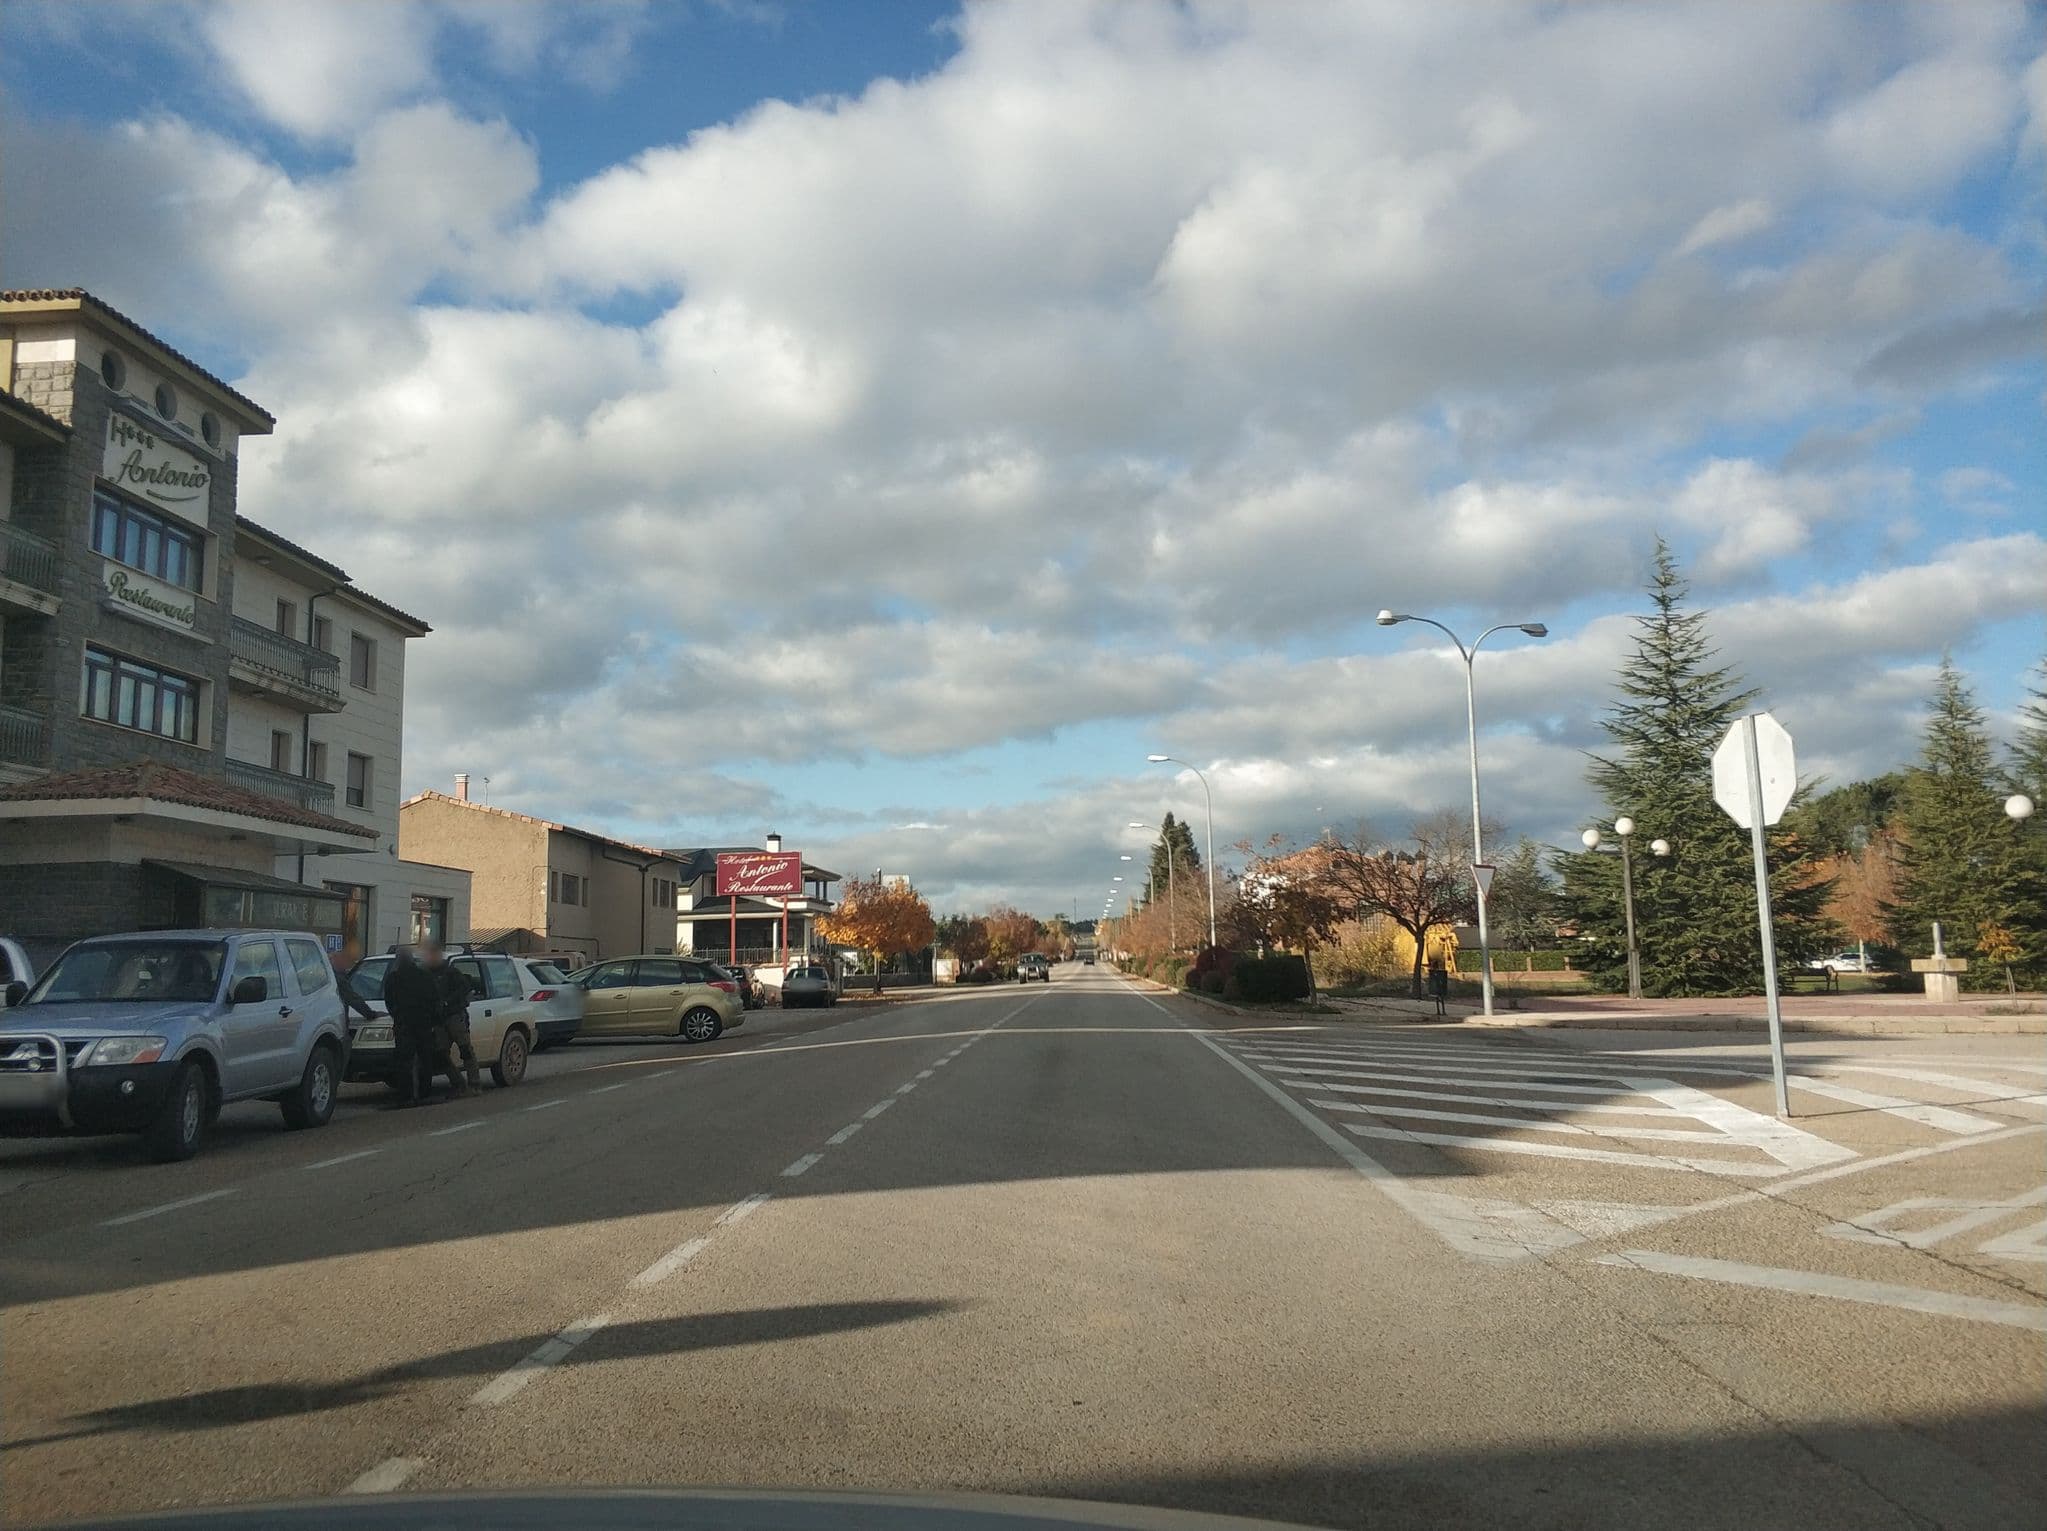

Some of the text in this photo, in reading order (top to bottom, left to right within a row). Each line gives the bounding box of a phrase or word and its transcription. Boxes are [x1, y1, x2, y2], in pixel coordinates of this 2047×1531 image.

[110, 449, 209, 488] Antonio
[110, 571, 193, 624] Restaurante
[729, 860, 788, 881] Antonio
[724, 881, 793, 893] Restaurante
